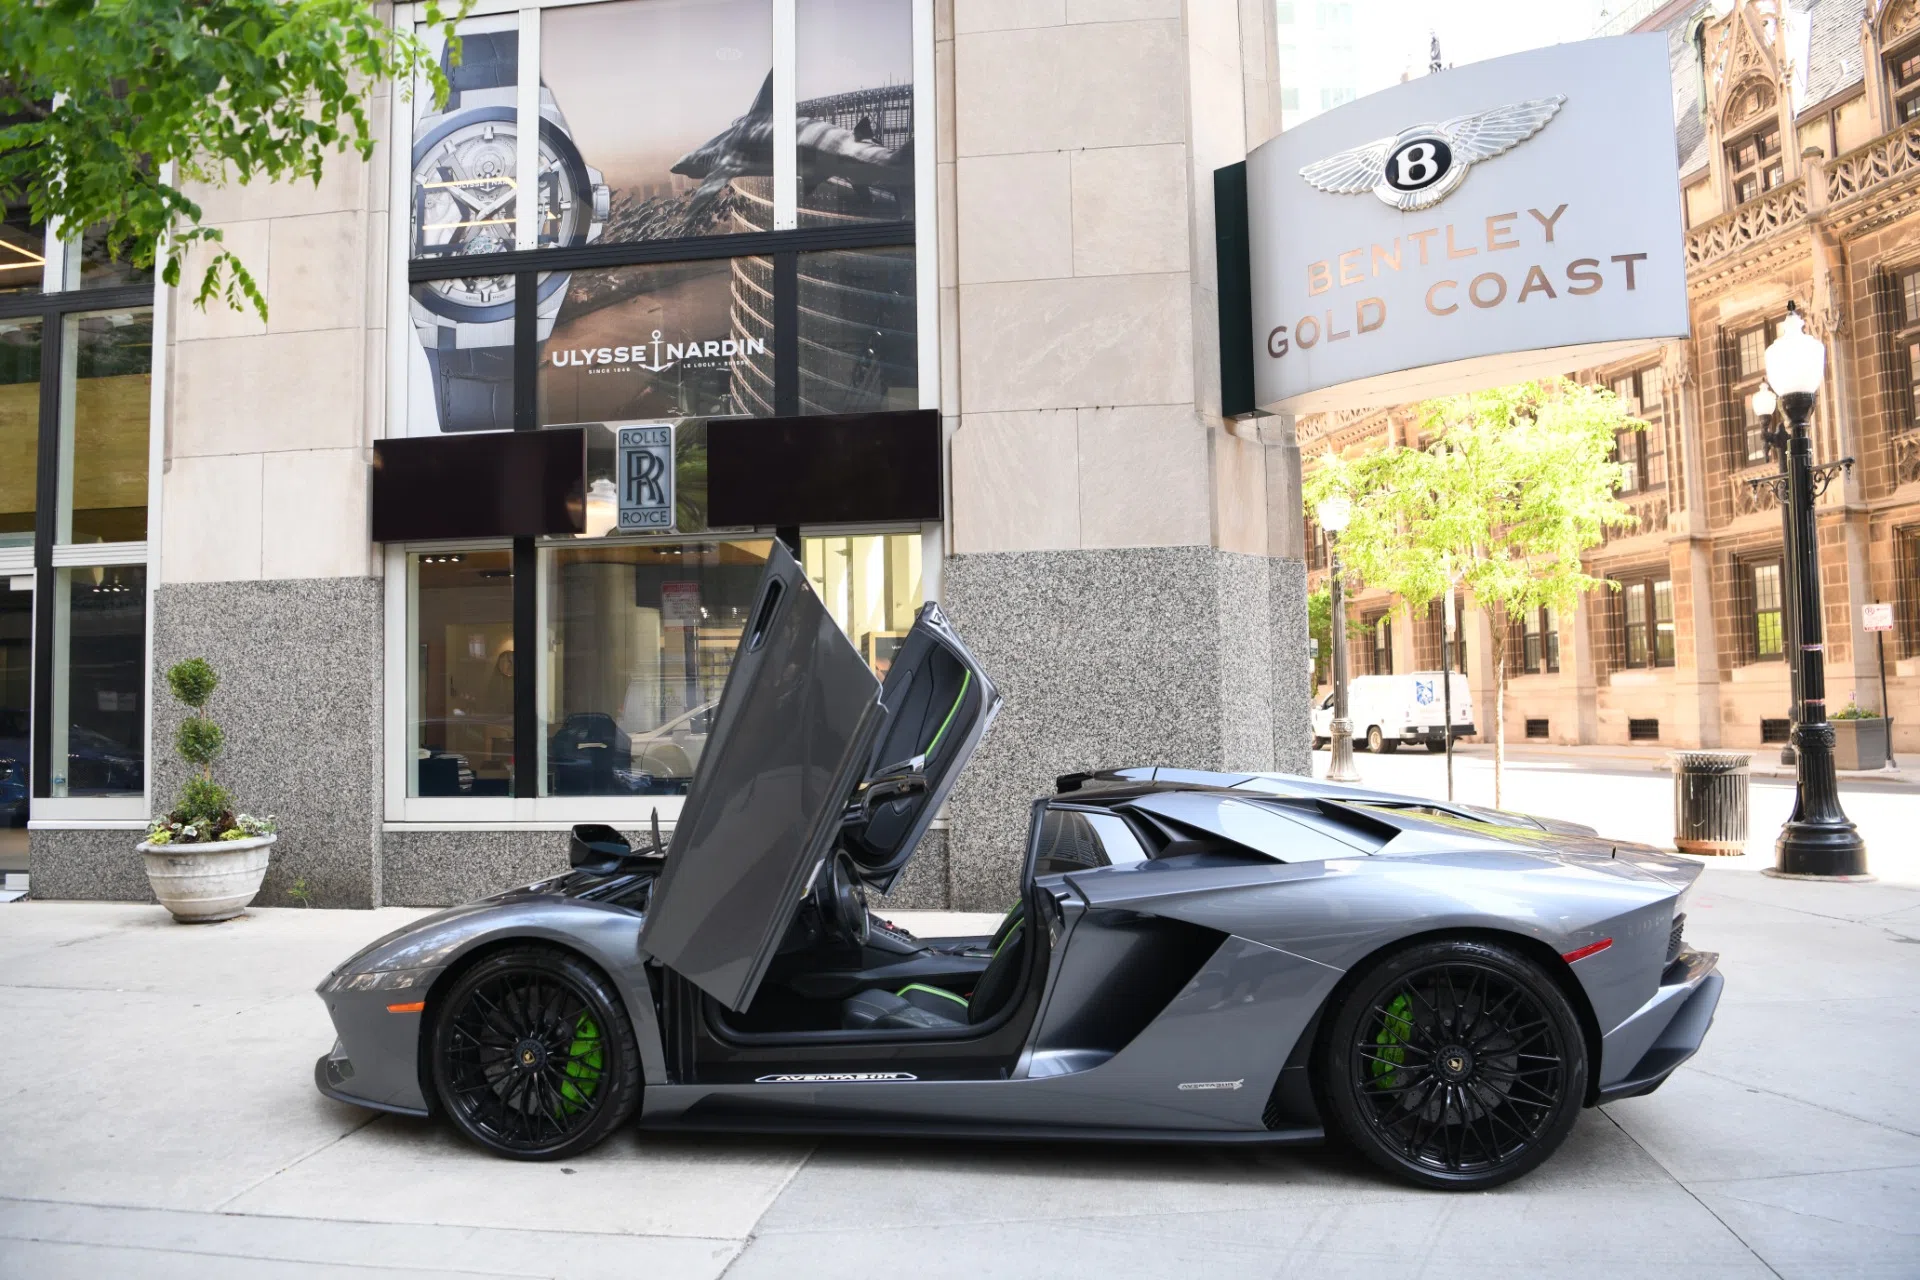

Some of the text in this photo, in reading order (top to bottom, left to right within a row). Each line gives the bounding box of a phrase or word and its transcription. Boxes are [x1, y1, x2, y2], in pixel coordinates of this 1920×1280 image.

[1395, 142, 1439, 186] B
[1308, 203, 1569, 297] BENTLEY
[1266, 252, 1648, 359] GOLD COAST
[552, 337, 765, 367] ULYSSE NARDIN
[622, 431, 667, 445] ROLLS
[622, 511, 668, 524] ROYCE
